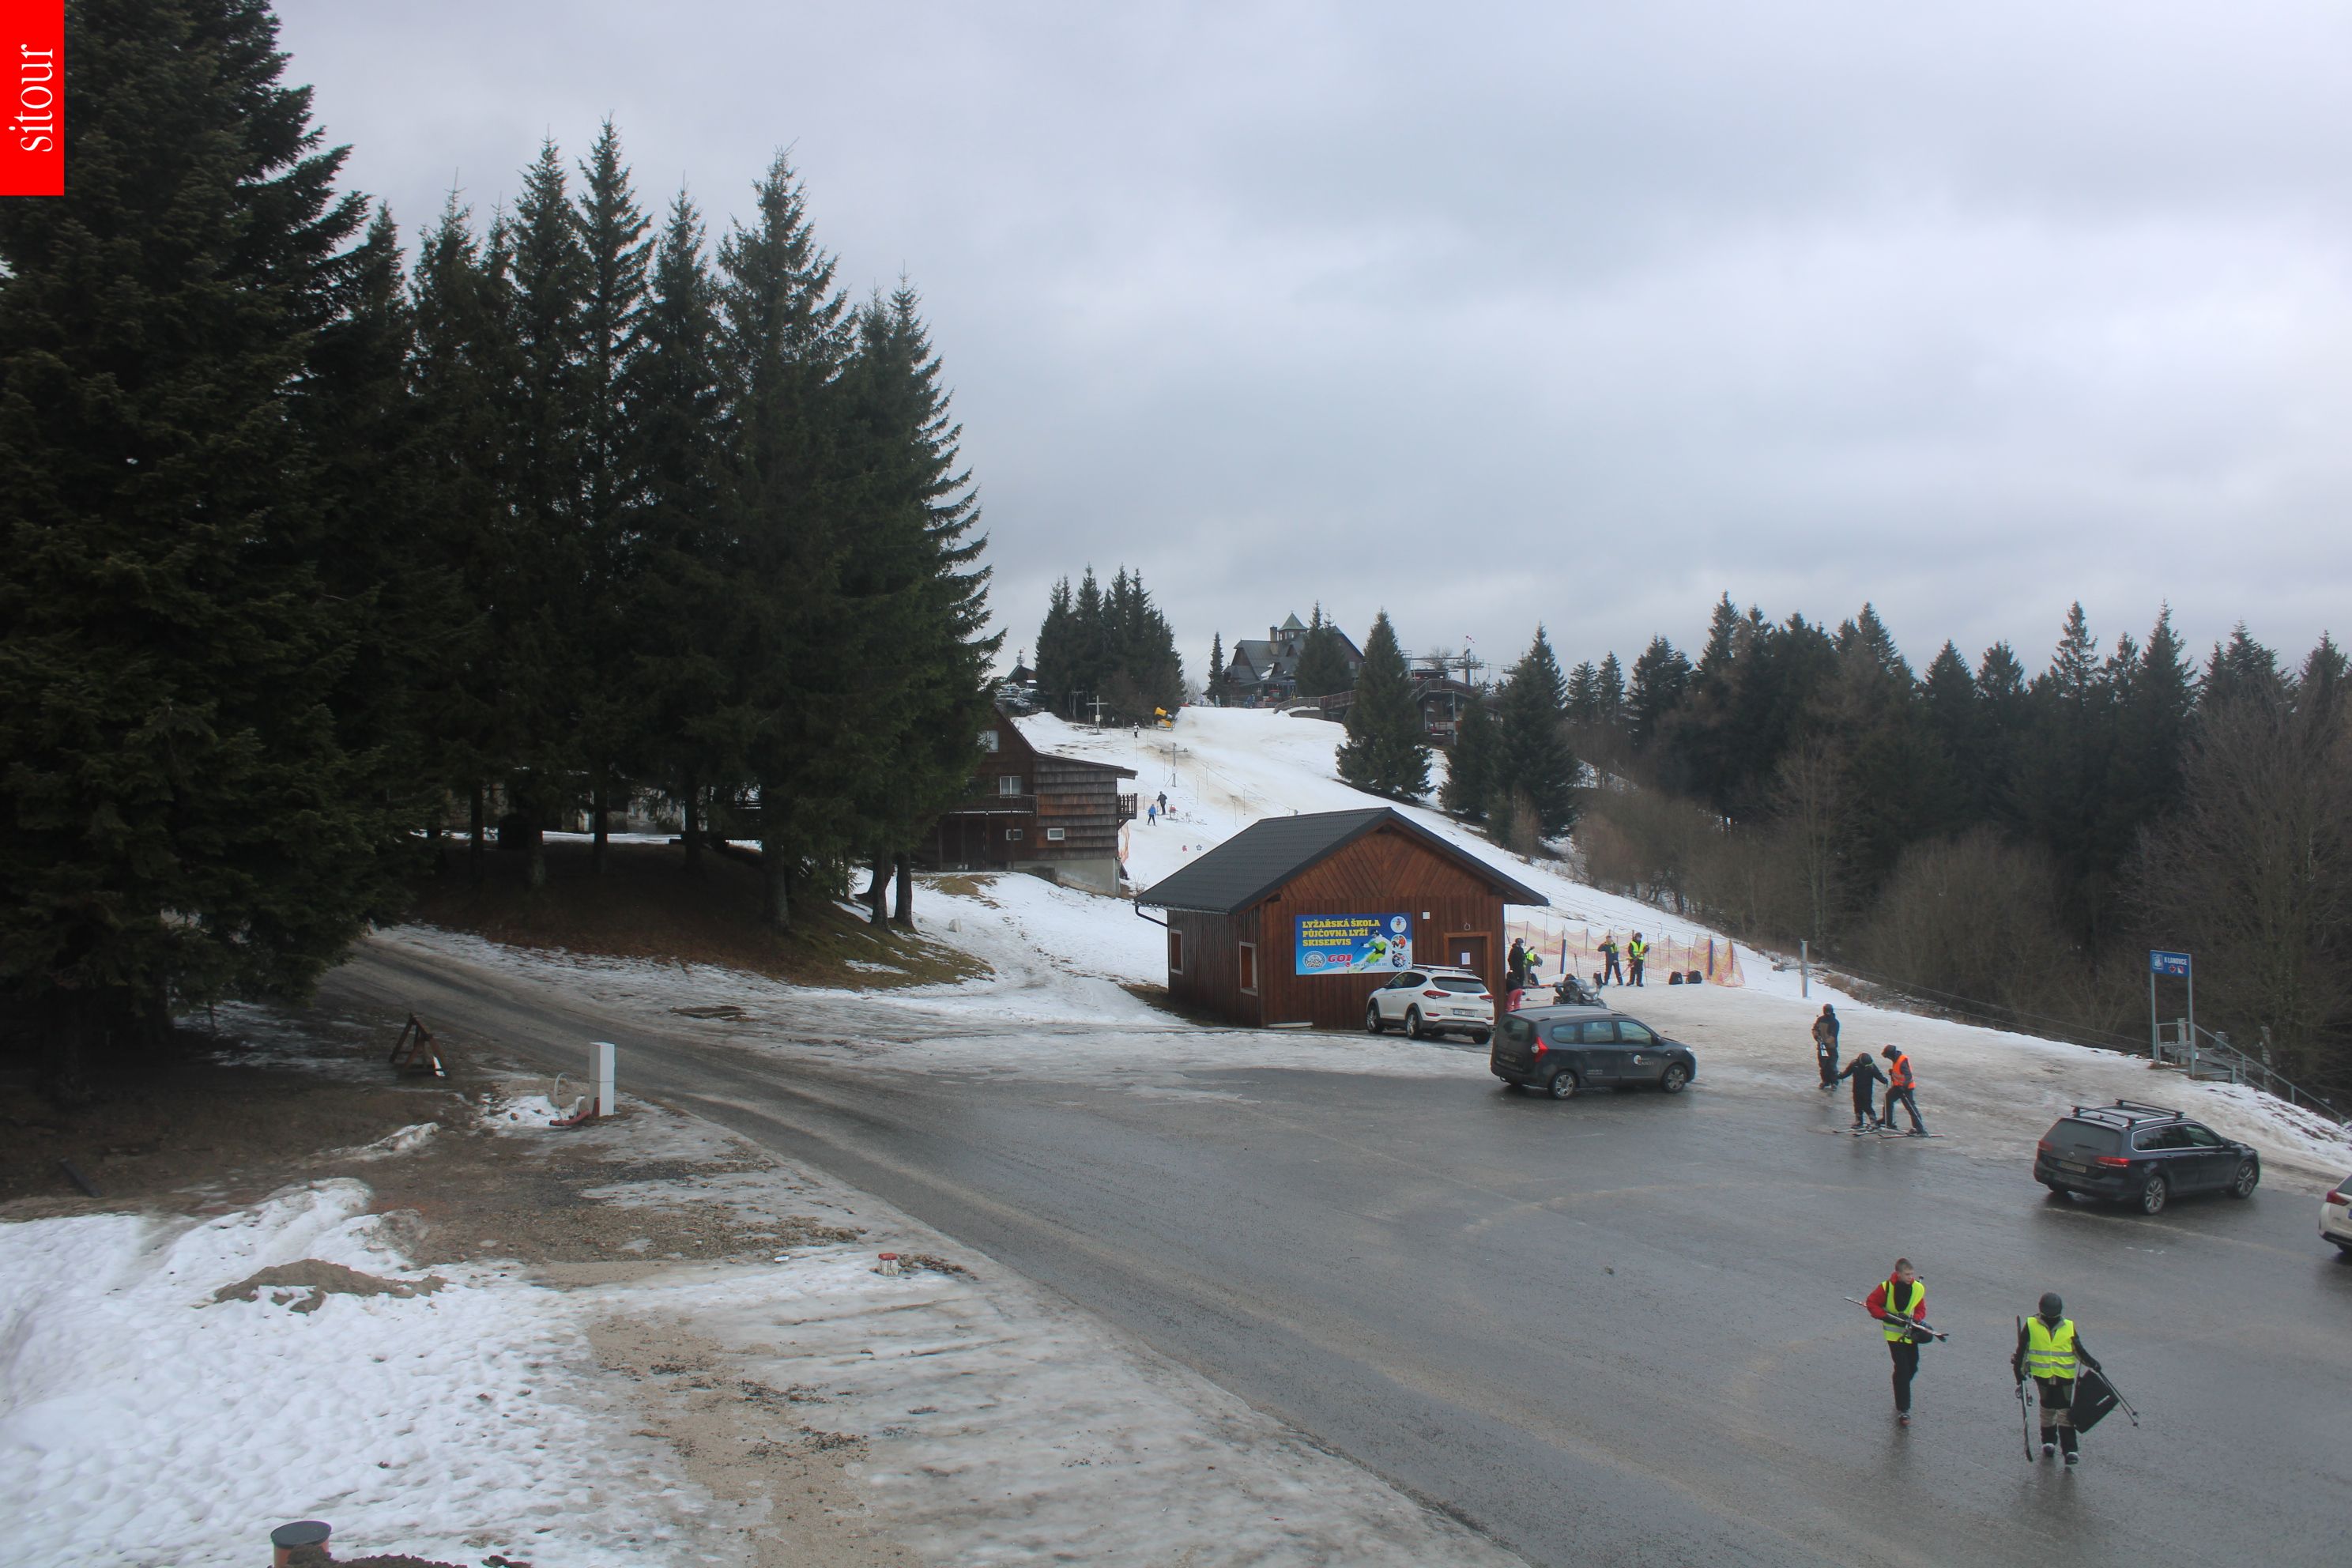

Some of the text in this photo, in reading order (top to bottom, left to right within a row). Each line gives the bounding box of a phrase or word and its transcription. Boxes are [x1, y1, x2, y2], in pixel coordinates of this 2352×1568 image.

[1302, 918, 1381, 928] LYŽAŘSKÁ ŠKOLA
[1302, 927, 1369, 937] PŮJČOVNA LYŽÍ
[1302, 938, 1351, 947] SKISERVIS
